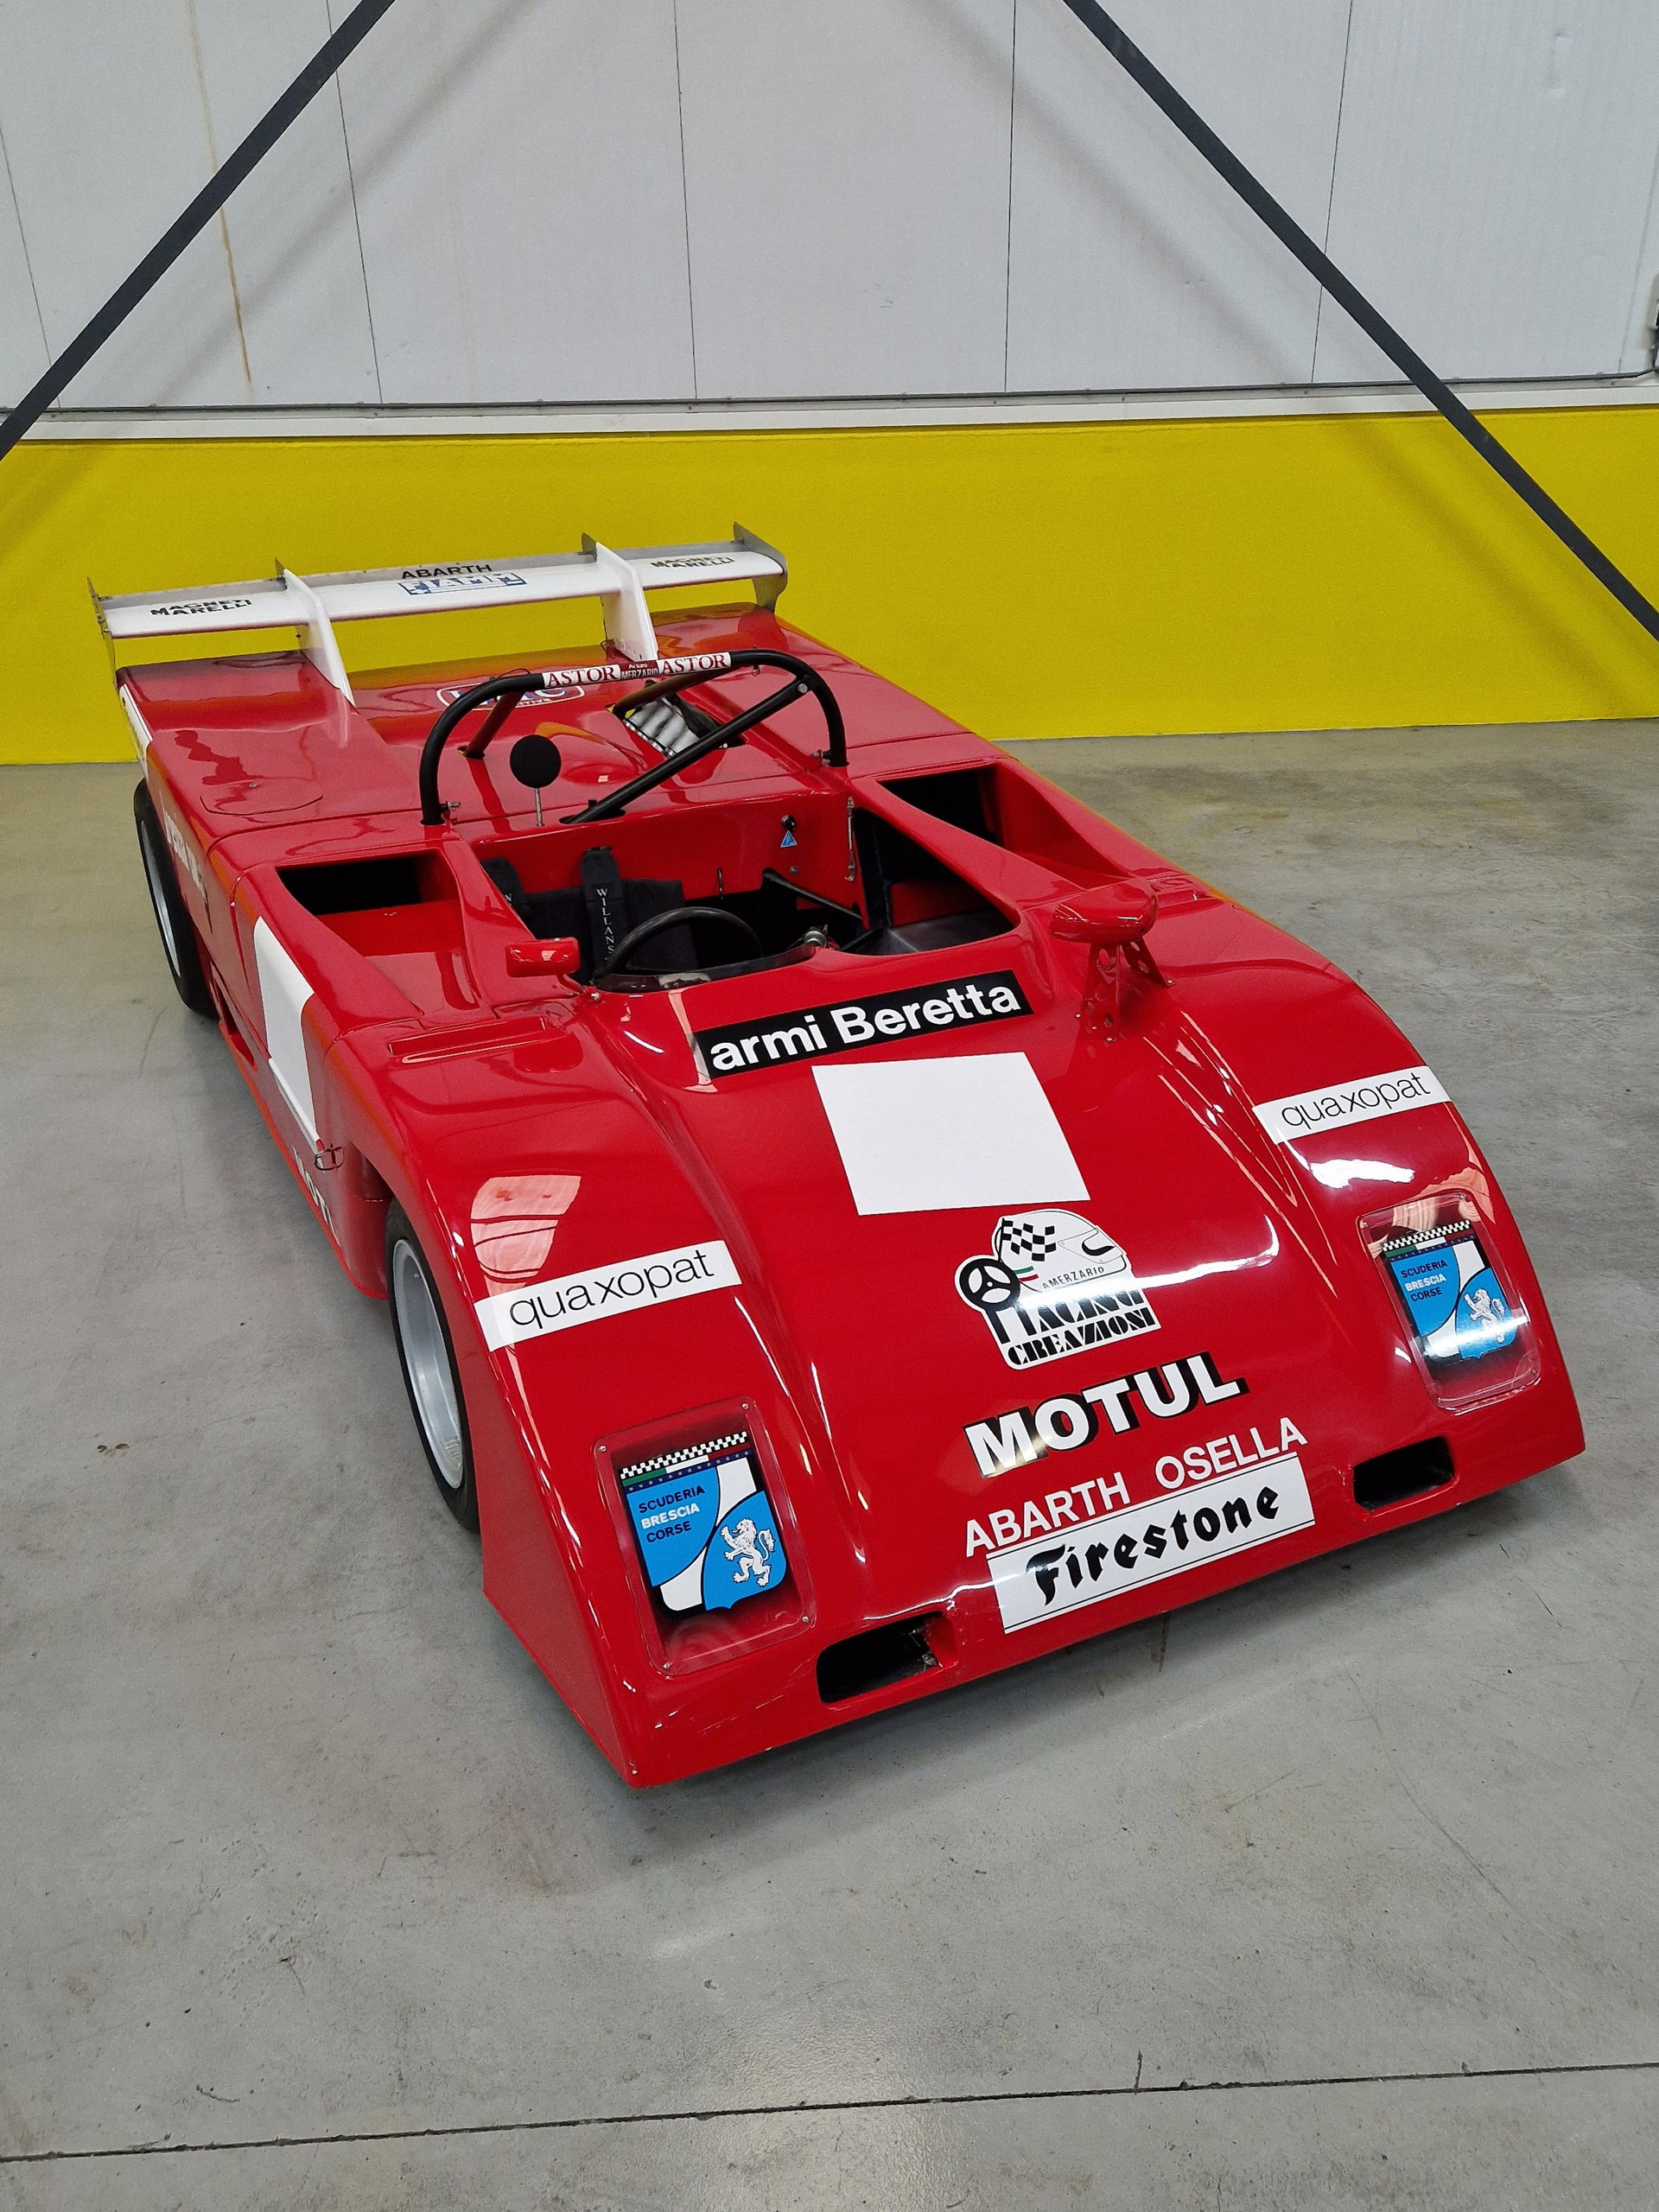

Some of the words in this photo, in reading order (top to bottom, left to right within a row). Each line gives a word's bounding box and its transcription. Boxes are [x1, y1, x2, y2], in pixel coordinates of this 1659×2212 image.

[401, 563, 493, 580] ABARTH
[150, 600, 252, 615] MARELLI
[547, 666, 620, 687] ASTOR
[621, 667, 658, 679] MERZARIO
[663, 653, 729, 674] ASTOR
[596, 888, 615, 954] WILLANS
[709, 1019, 830, 1071] armi
[830, 983, 1021, 1046] Beretta
[1281, 1072, 1431, 1129] quaxopat
[1401, 1259, 1448, 1279] SCUDERIA
[509, 1249, 715, 1329] quaxopat
[1404, 1273, 1446, 1292] BRESCIA
[1410, 1287, 1443, 1302] CORSE
[1007, 1306, 1156, 1365] CREAZIONI
[963, 1351, 1249, 1478] MOTUL
[639, 1484, 705, 1514] SCUDERIA
[965, 1471, 1130, 1558] ABARTH
[1154, 1416, 1308, 1490] OSELLA
[640, 1503, 701, 1529] BRESCIA
[646, 1521, 692, 1543] CORSE
[1025, 1485, 1279, 1606] Firestone
